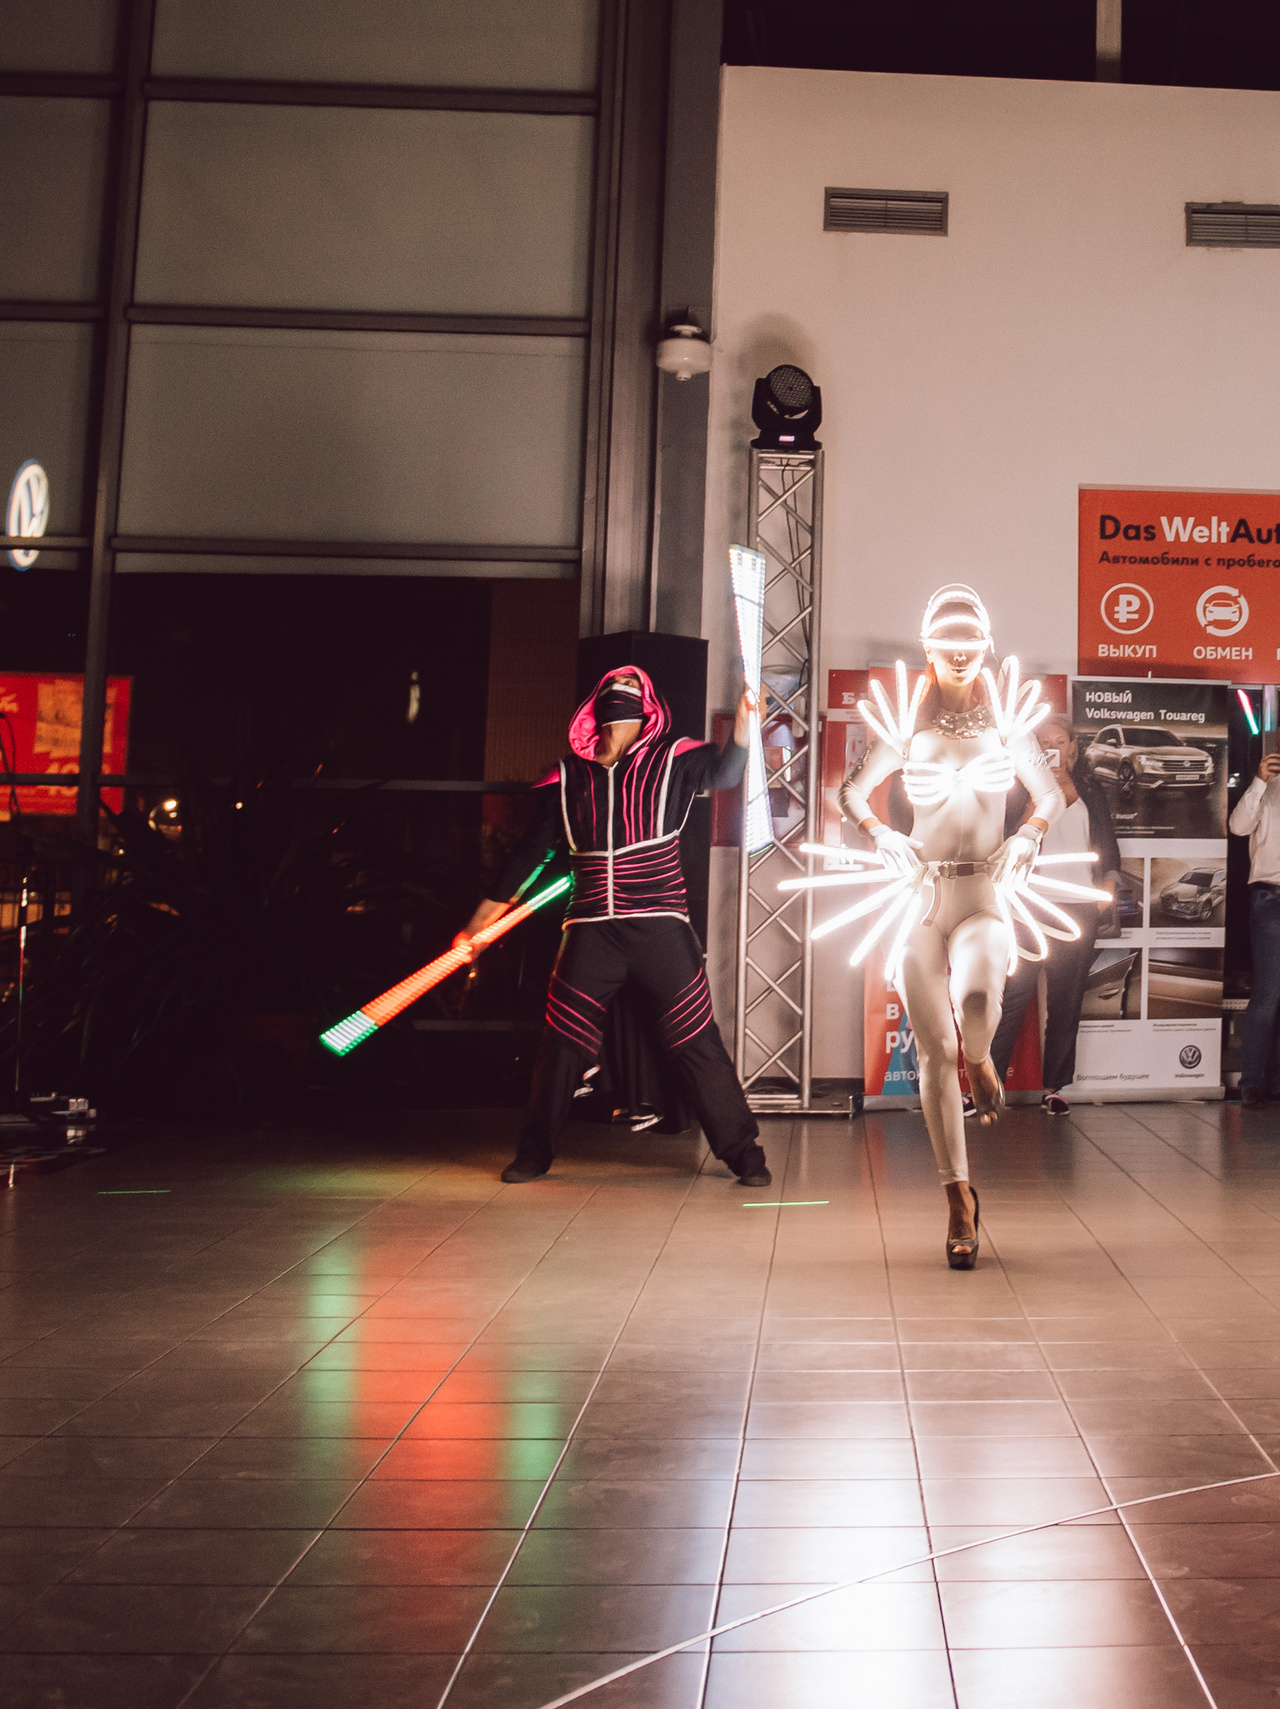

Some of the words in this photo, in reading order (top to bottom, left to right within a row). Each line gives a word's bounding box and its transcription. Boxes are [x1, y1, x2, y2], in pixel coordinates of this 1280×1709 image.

[1100, 514, 1157, 541] Das
[1099, 551, 1199, 566] Автомобили
[1204, 557, 1212, 566] с
[1098, 644, 1157, 657] ВЫКУП
[1193, 646, 1253, 660] ОБМЕН
[1085, 690, 1132, 703] НОВЫЙ
[1085, 707, 1154, 721] Volkswagen
[1160, 709, 1206, 723] Touareg
[885, 1030, 915, 1053] ру
